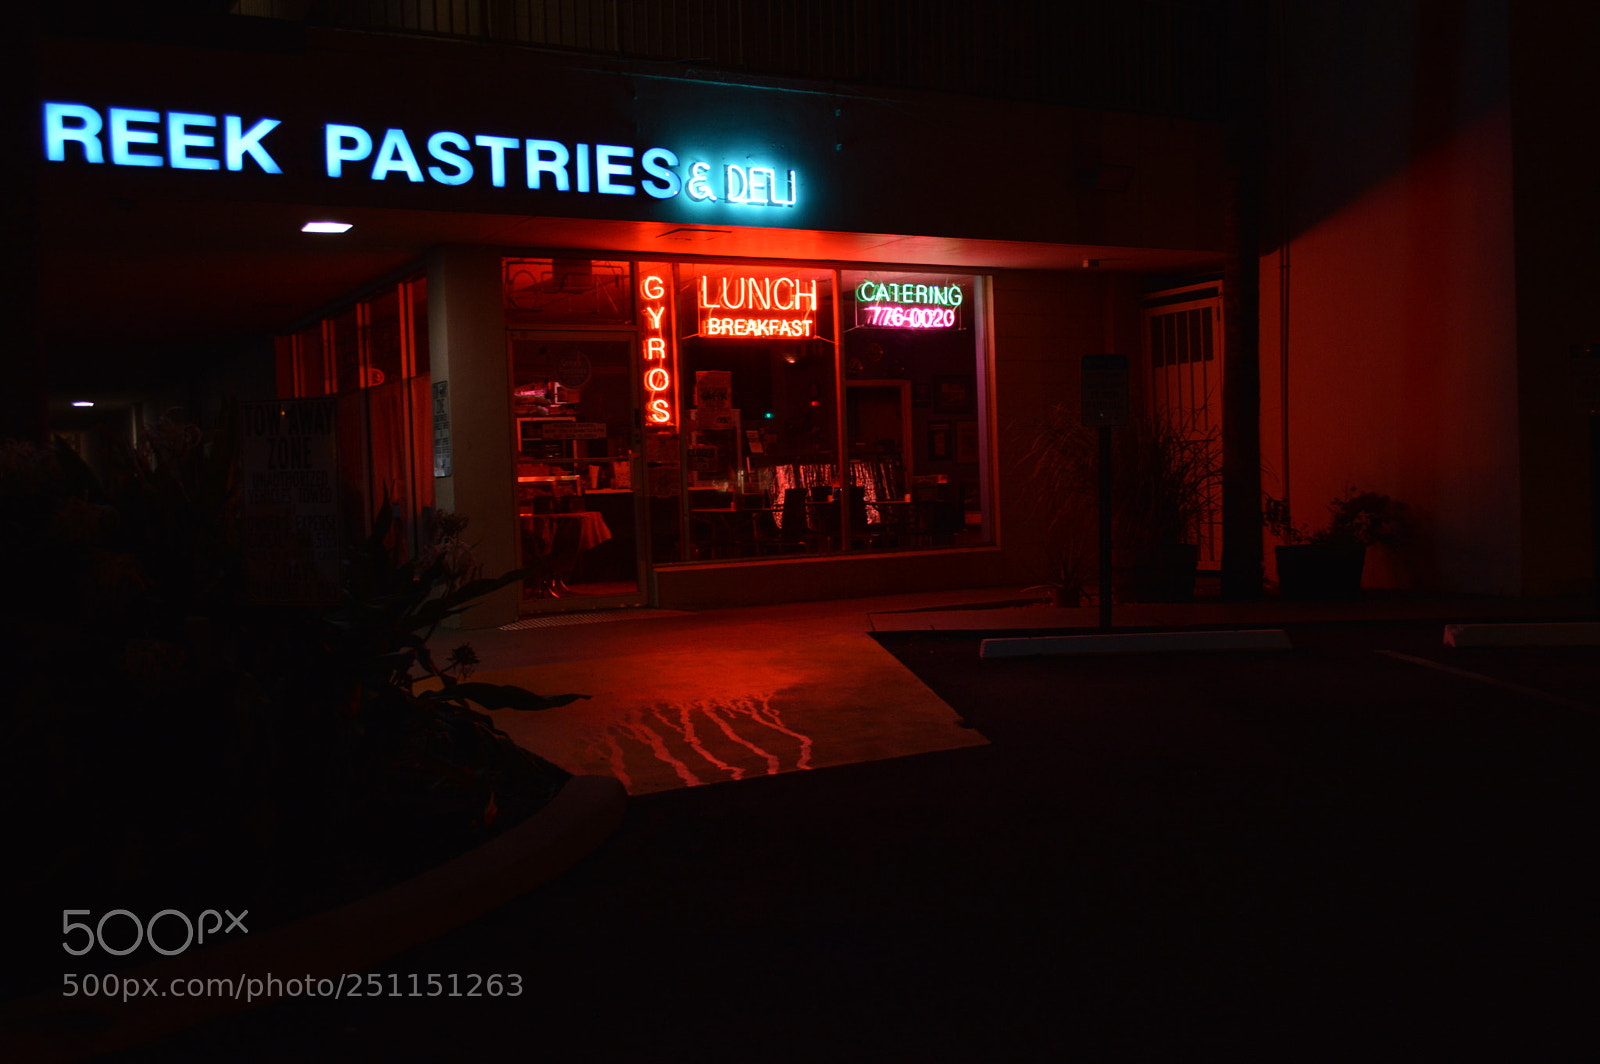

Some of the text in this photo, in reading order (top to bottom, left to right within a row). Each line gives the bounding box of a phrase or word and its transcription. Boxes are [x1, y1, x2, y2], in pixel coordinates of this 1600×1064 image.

[43, 101, 796, 207] REEK PASTRIES & DELI
[701, 275, 818, 311] LUNCH
[858, 281, 963, 306] CATERING
[706, 317, 813, 337] BREAKFAST
[866, 305, 955, 328] 776-0020
[640, 275, 671, 424] GYROS
[242, 402, 334, 436] TOW AWAY
[267, 437, 313, 469] ZONE
